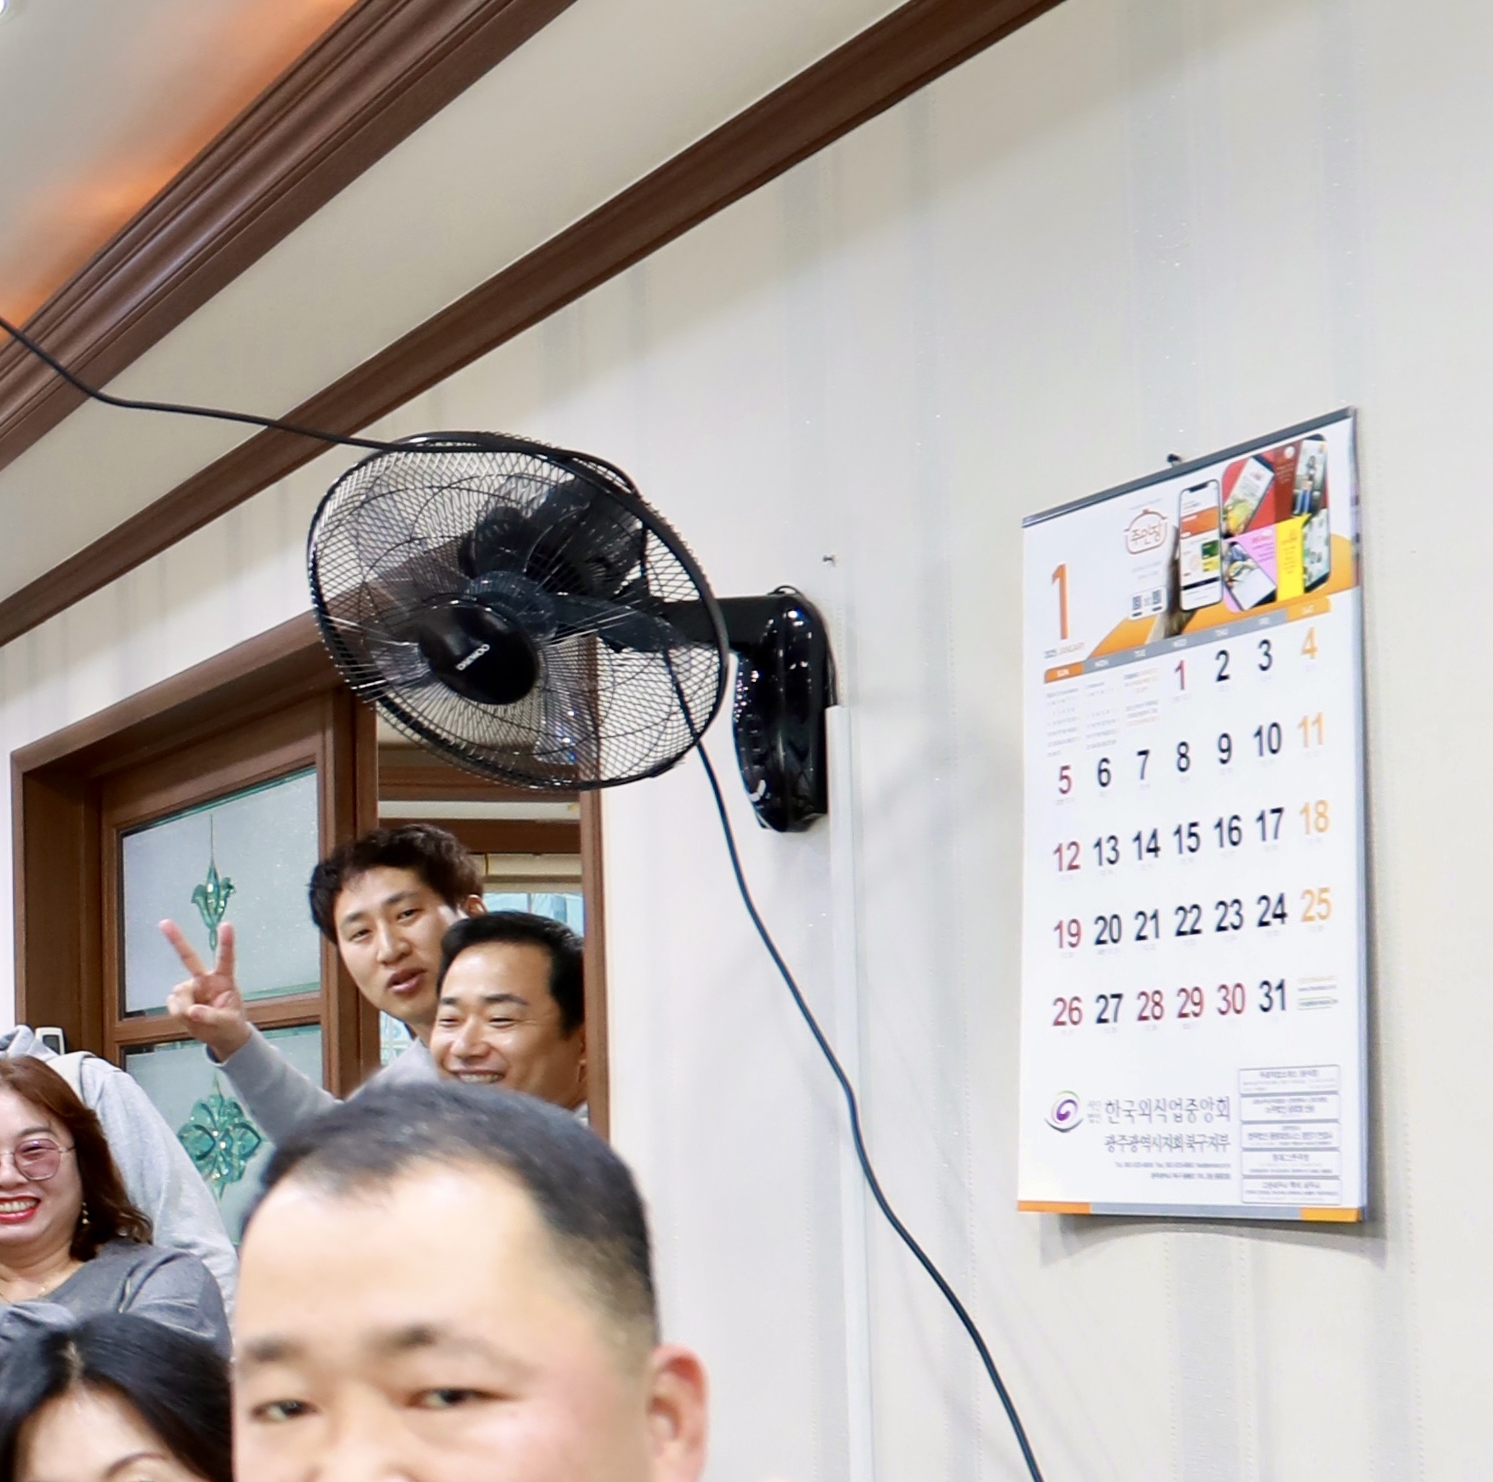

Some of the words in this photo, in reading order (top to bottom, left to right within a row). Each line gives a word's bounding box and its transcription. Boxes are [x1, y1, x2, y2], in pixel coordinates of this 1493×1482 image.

[1051, 563, 1069, 641] 1
[1174, 660, 1185, 690] 1
[1215, 650, 1230, 682] 2
[1258, 639, 1273, 671] 3
[1301, 627, 1318, 660] 4
[1058, 765, 1073, 795] 5
[1097, 758, 1112, 788] 6
[1136, 749, 1151, 781] 7
[1176, 741, 1191, 773] 8
[1218, 732, 1233, 765] 9
[1253, 722, 1283, 757] 10
[1298, 712, 1324, 748] 11
[1053, 841, 1081, 872] 12
[1093, 835, 1120, 867] 13
[1132, 828, 1161, 861] 14
[1173, 821, 1201, 855] 15
[1214, 814, 1243, 848] 16
[1256, 807, 1285, 841] 17
[1300, 799, 1330, 835] 18
[1054, 918, 1082, 949] 19
[1094, 914, 1122, 945] 20
[1134, 909, 1160, 941] 21
[1175, 904, 1202, 937] 22
[1215, 898, 1244, 932] 23
[1257, 893, 1288, 927] 24
[1300, 886, 1331, 922] 25
[1053, 996, 1083, 1027] 26
[1095, 993, 1124, 1024] 27
[1137, 990, 1164, 1021] 28
[1177, 986, 1204, 1018] 29
[1217, 983, 1245, 1015] 30
[1259, 979, 1286, 1012] 31
[1105, 1096, 1231, 1124] 한국외식업중앙회
